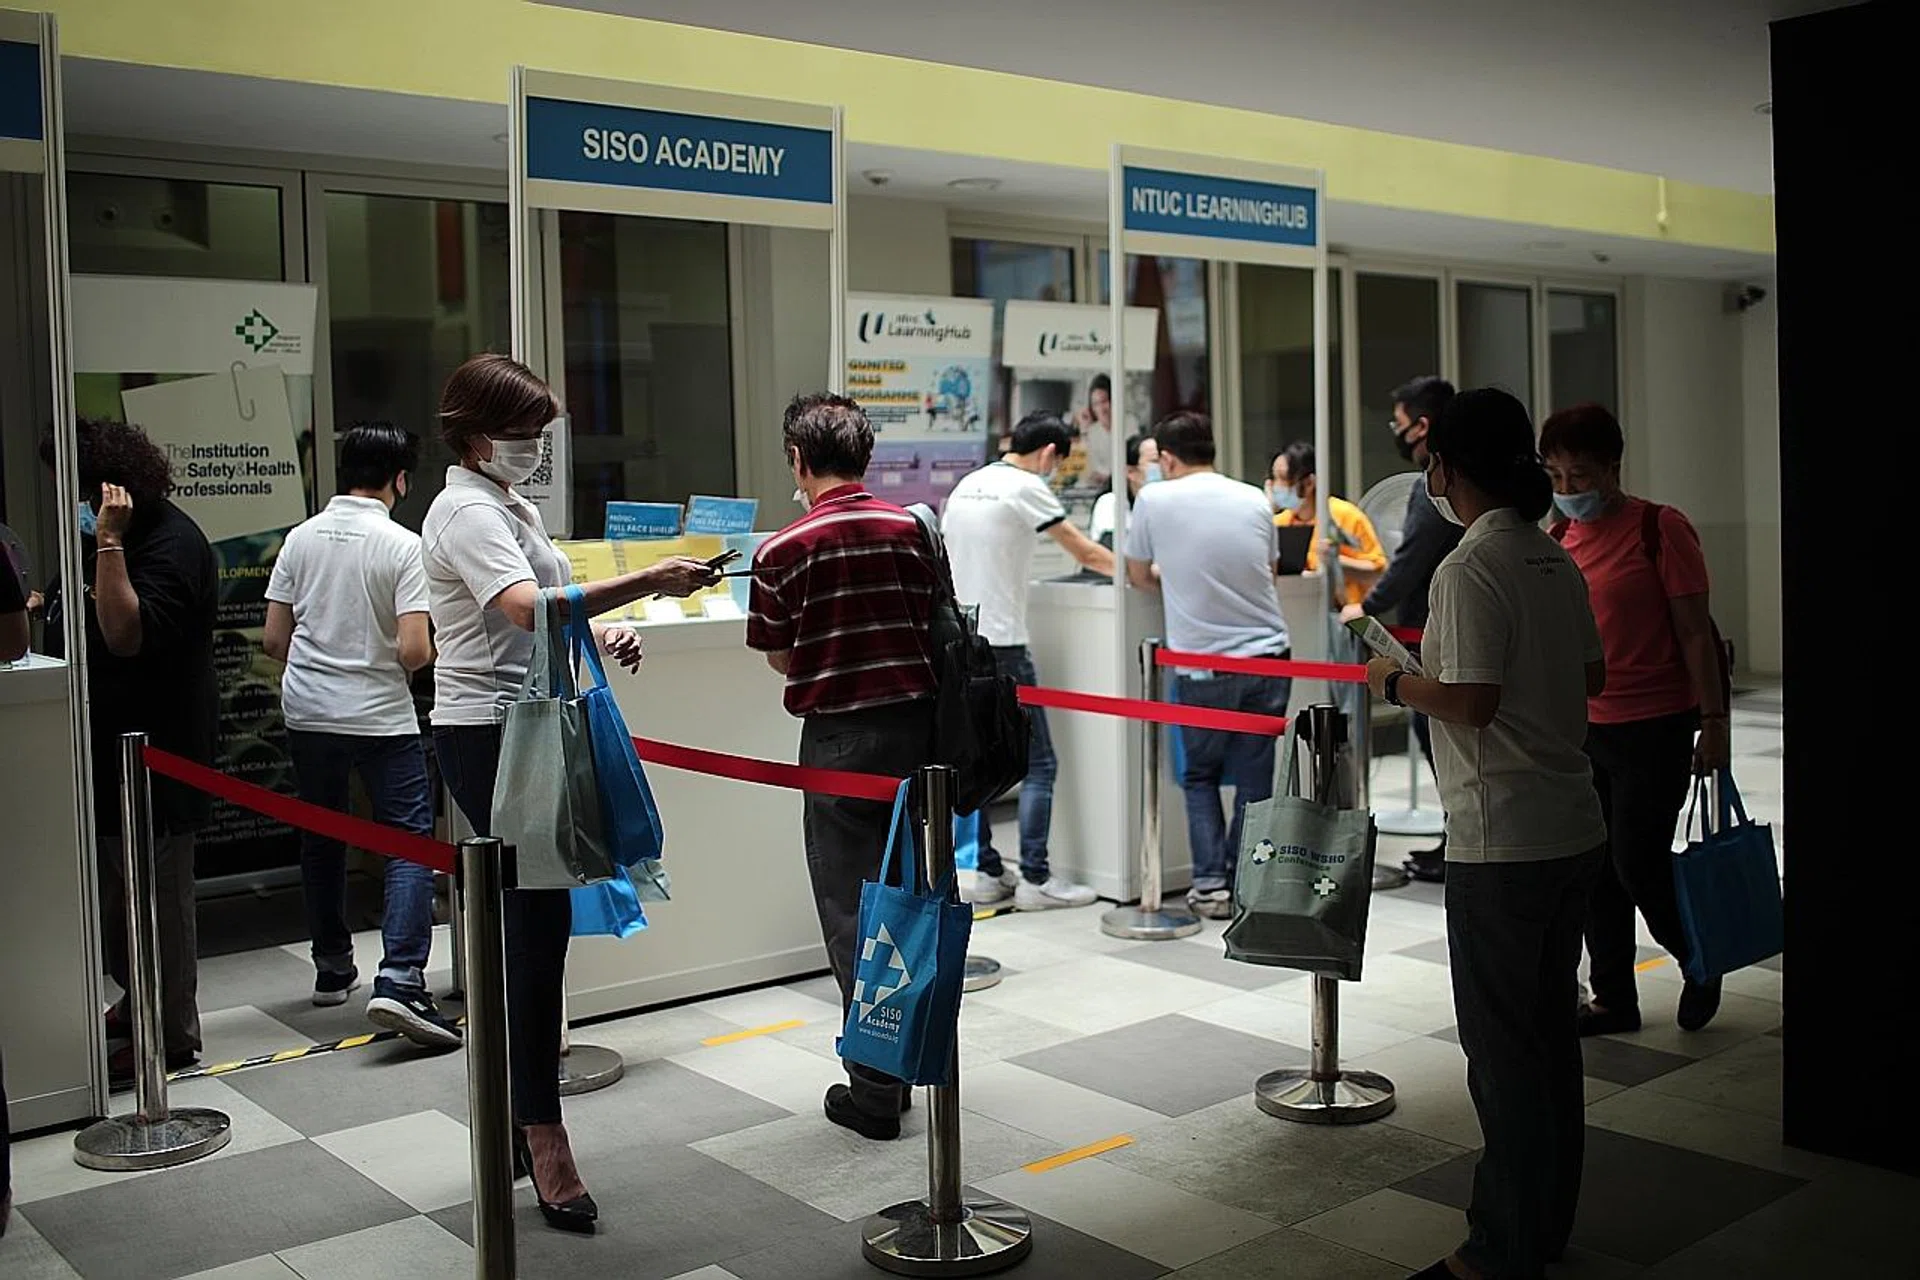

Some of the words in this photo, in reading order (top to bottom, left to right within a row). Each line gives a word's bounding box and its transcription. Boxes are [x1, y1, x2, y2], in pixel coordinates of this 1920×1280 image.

[583, 128, 648, 163] SISO
[655, 136, 784, 177] ACADEMY
[1132, 187, 1183, 216] NTUC
[1186, 193, 1308, 229] LEARNINGHUB
[888, 322, 971, 342] LearningHub
[1061, 341, 1111, 355] LearningH
[848, 360, 905, 370] GUNITED
[848, 374, 881, 384] KILLS
[849, 389, 919, 400] ROGRAMME
[169, 480, 272, 498] Professionals
[218, 566, 269, 579] ELOPMEN
[1280, 845, 1307, 857] SISO
[1278, 855, 1331, 871] Conference
[881, 1006, 902, 1021] SISO
[866, 1015, 900, 1034] Academy
